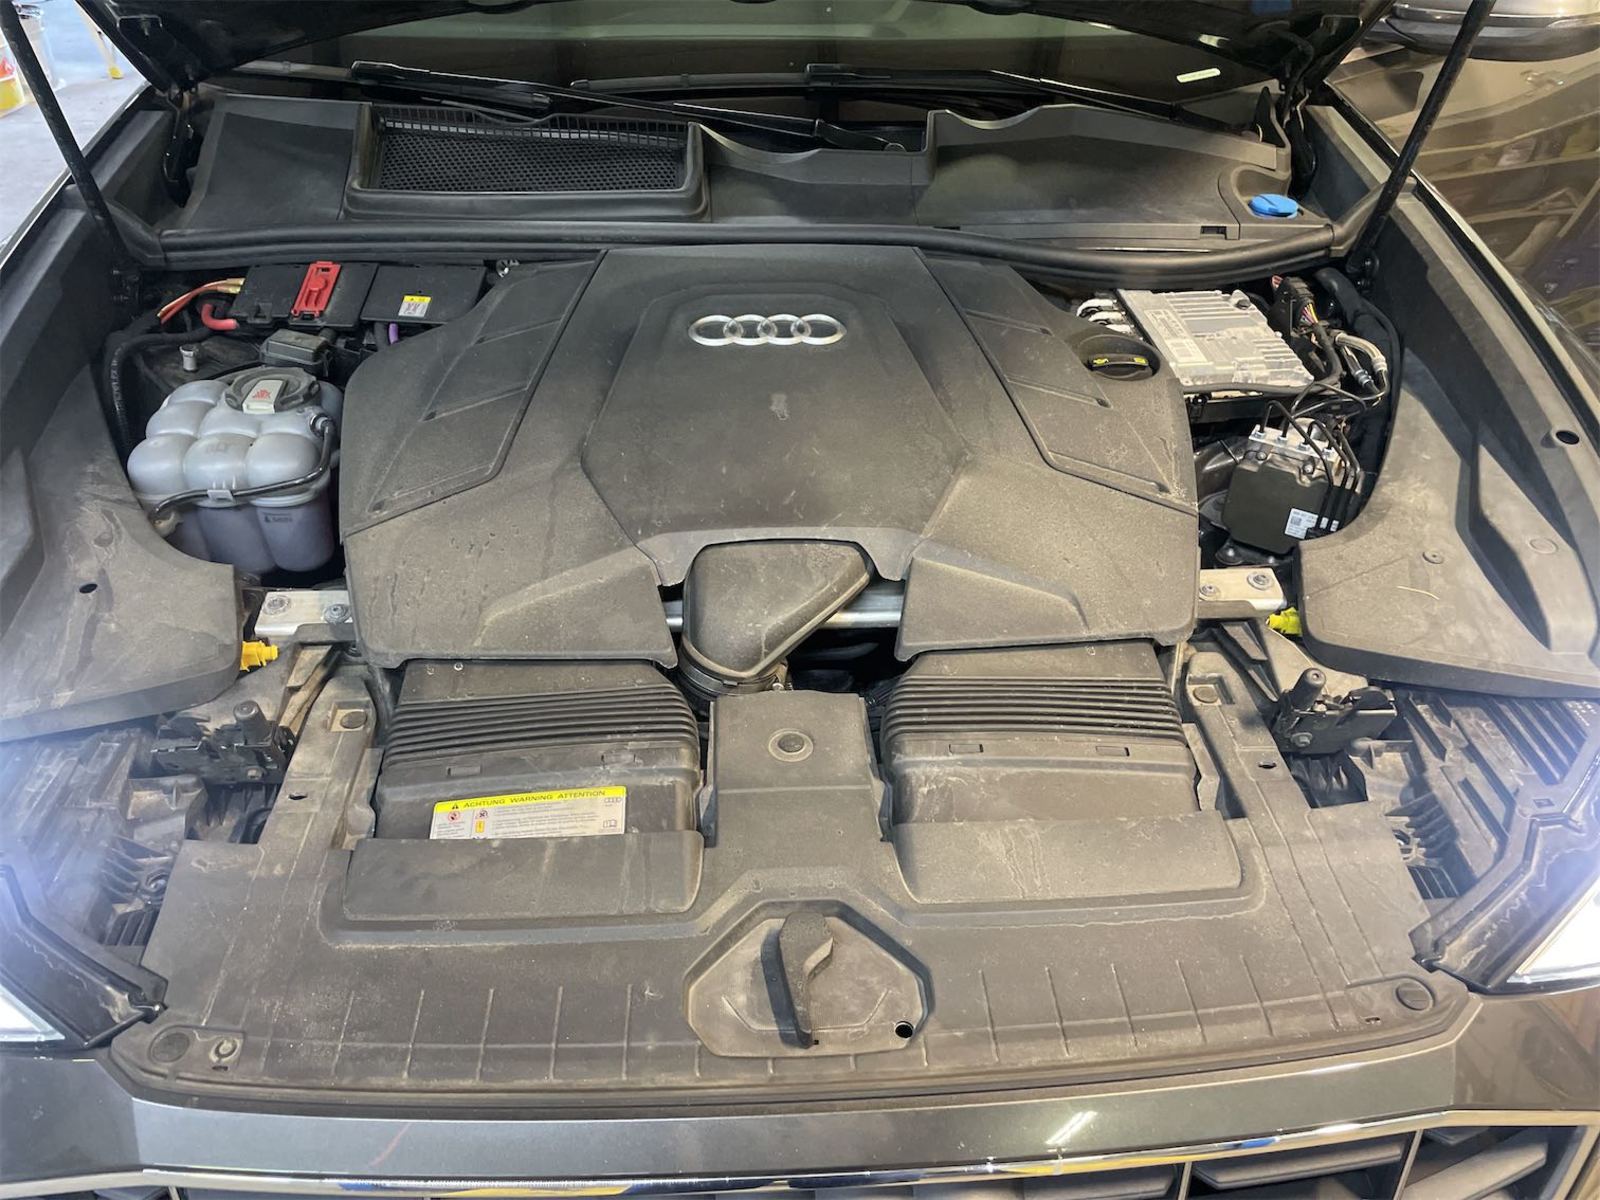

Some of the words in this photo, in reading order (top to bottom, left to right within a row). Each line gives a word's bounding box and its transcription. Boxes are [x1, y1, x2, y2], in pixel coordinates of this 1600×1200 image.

[463, 799, 506, 808] ACHTUNG
[510, 794, 553, 803] WARNING
[557, 790, 606, 799] ATTENTION
